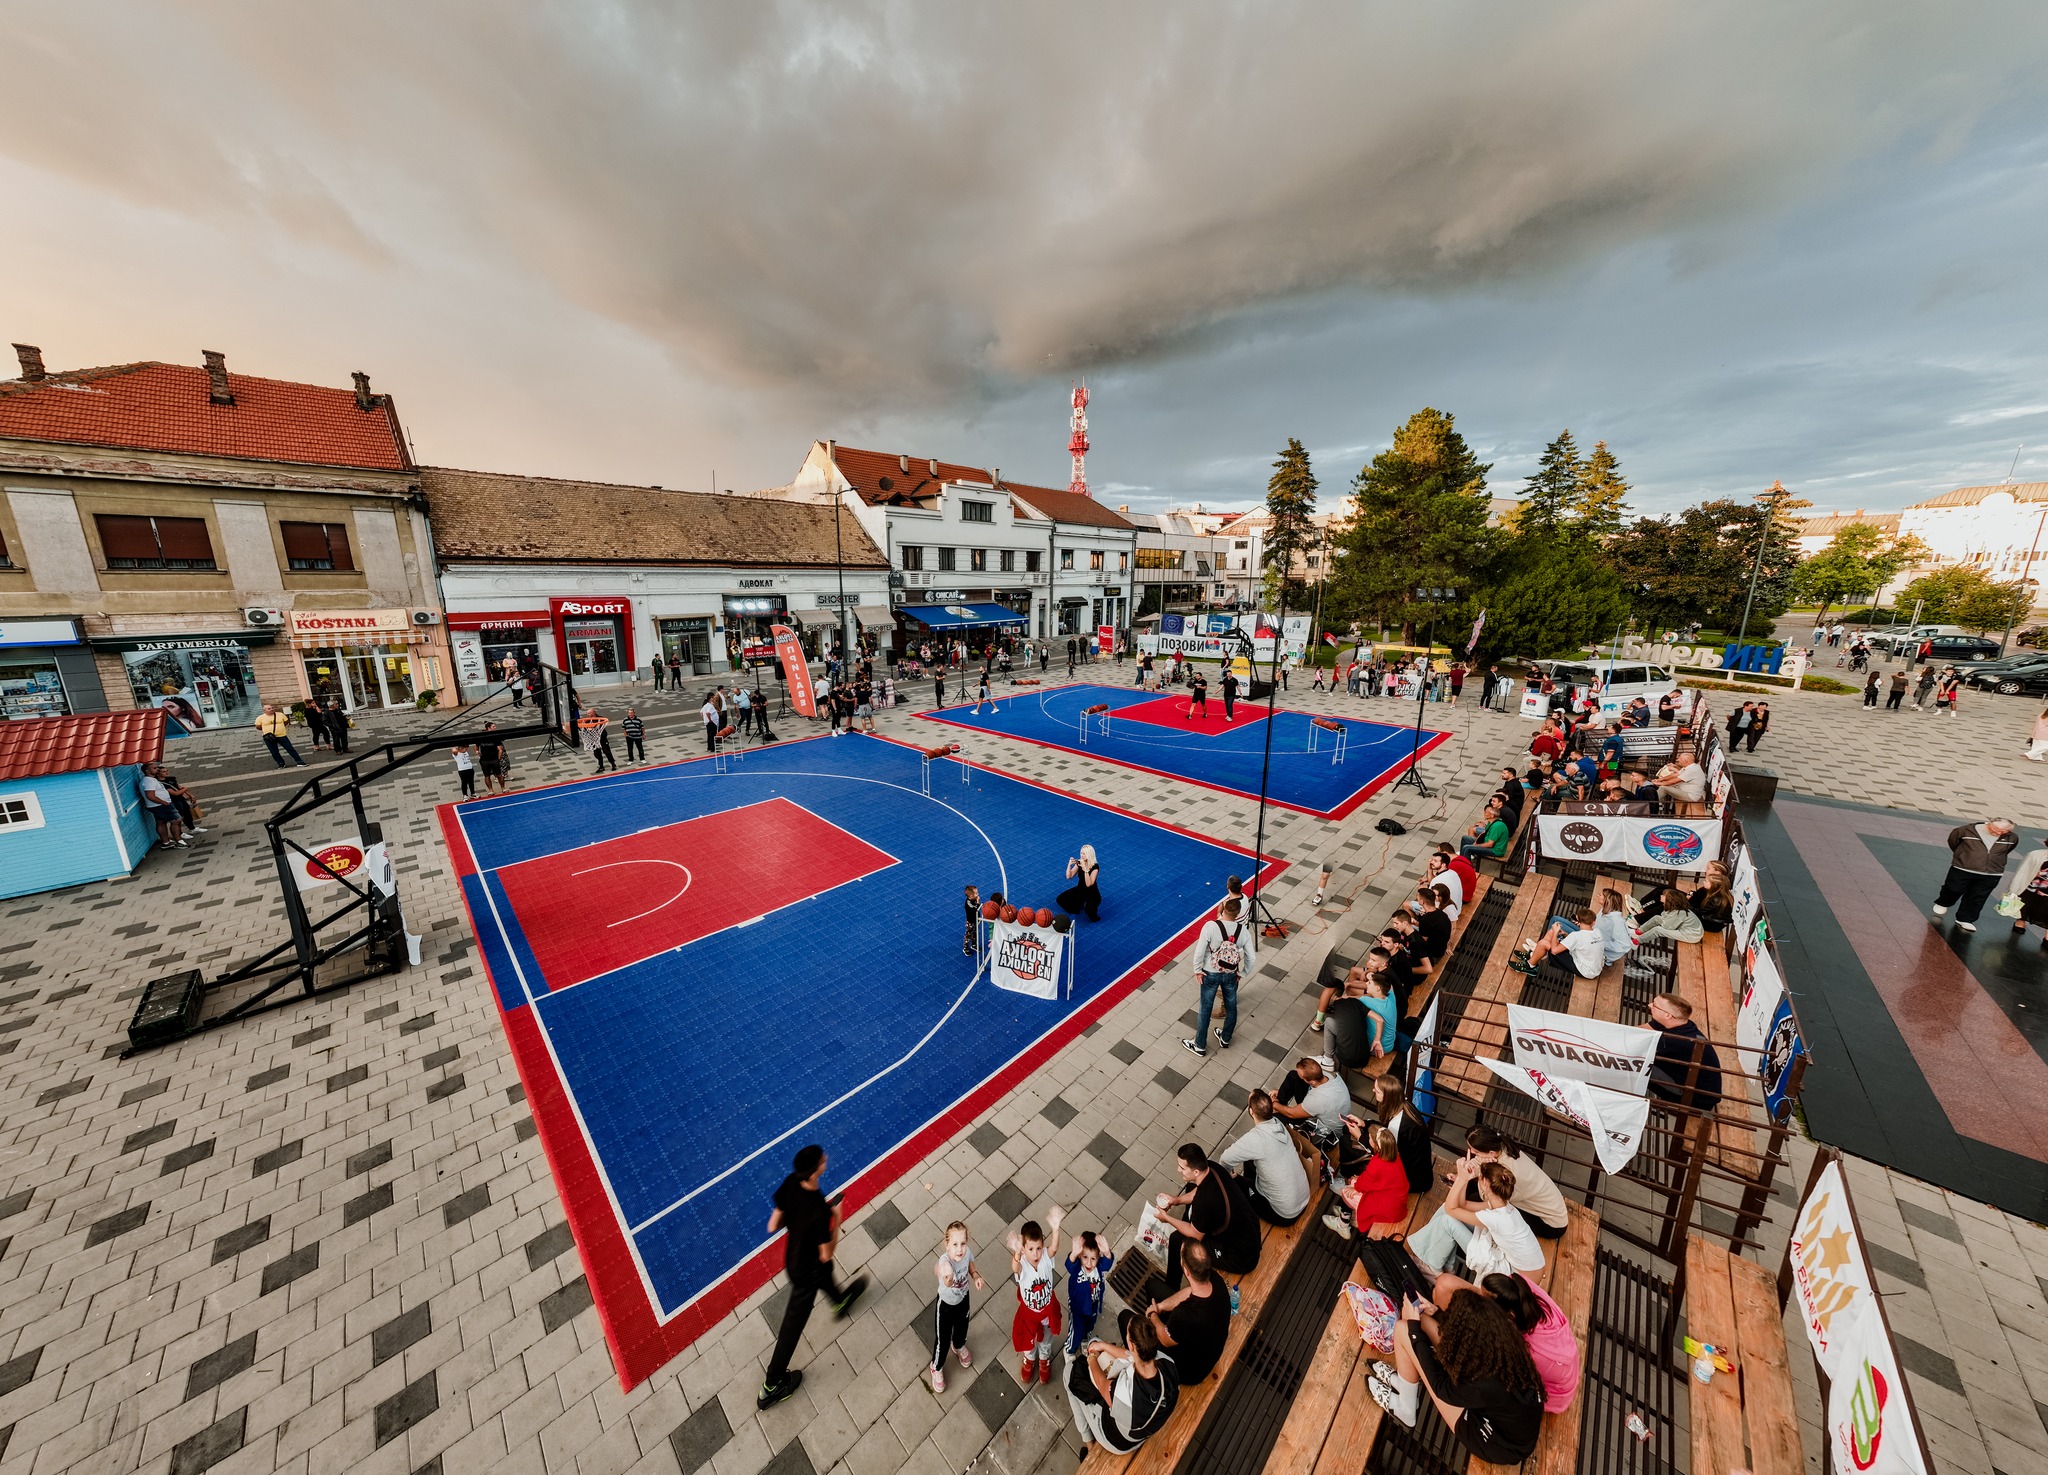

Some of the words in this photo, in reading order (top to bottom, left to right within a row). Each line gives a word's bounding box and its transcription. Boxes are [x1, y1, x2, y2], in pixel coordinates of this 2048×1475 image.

[739, 579, 773, 589] АДВОКАТ
[480, 621, 524, 630] АРМАНИ
[568, 628, 613, 637] ARMANI
[136, 639, 240, 651] PARFIMERIJA
[1161, 637, 1205, 653] ПОЗОВИ
[1656, 855, 1694, 866] FALCON
